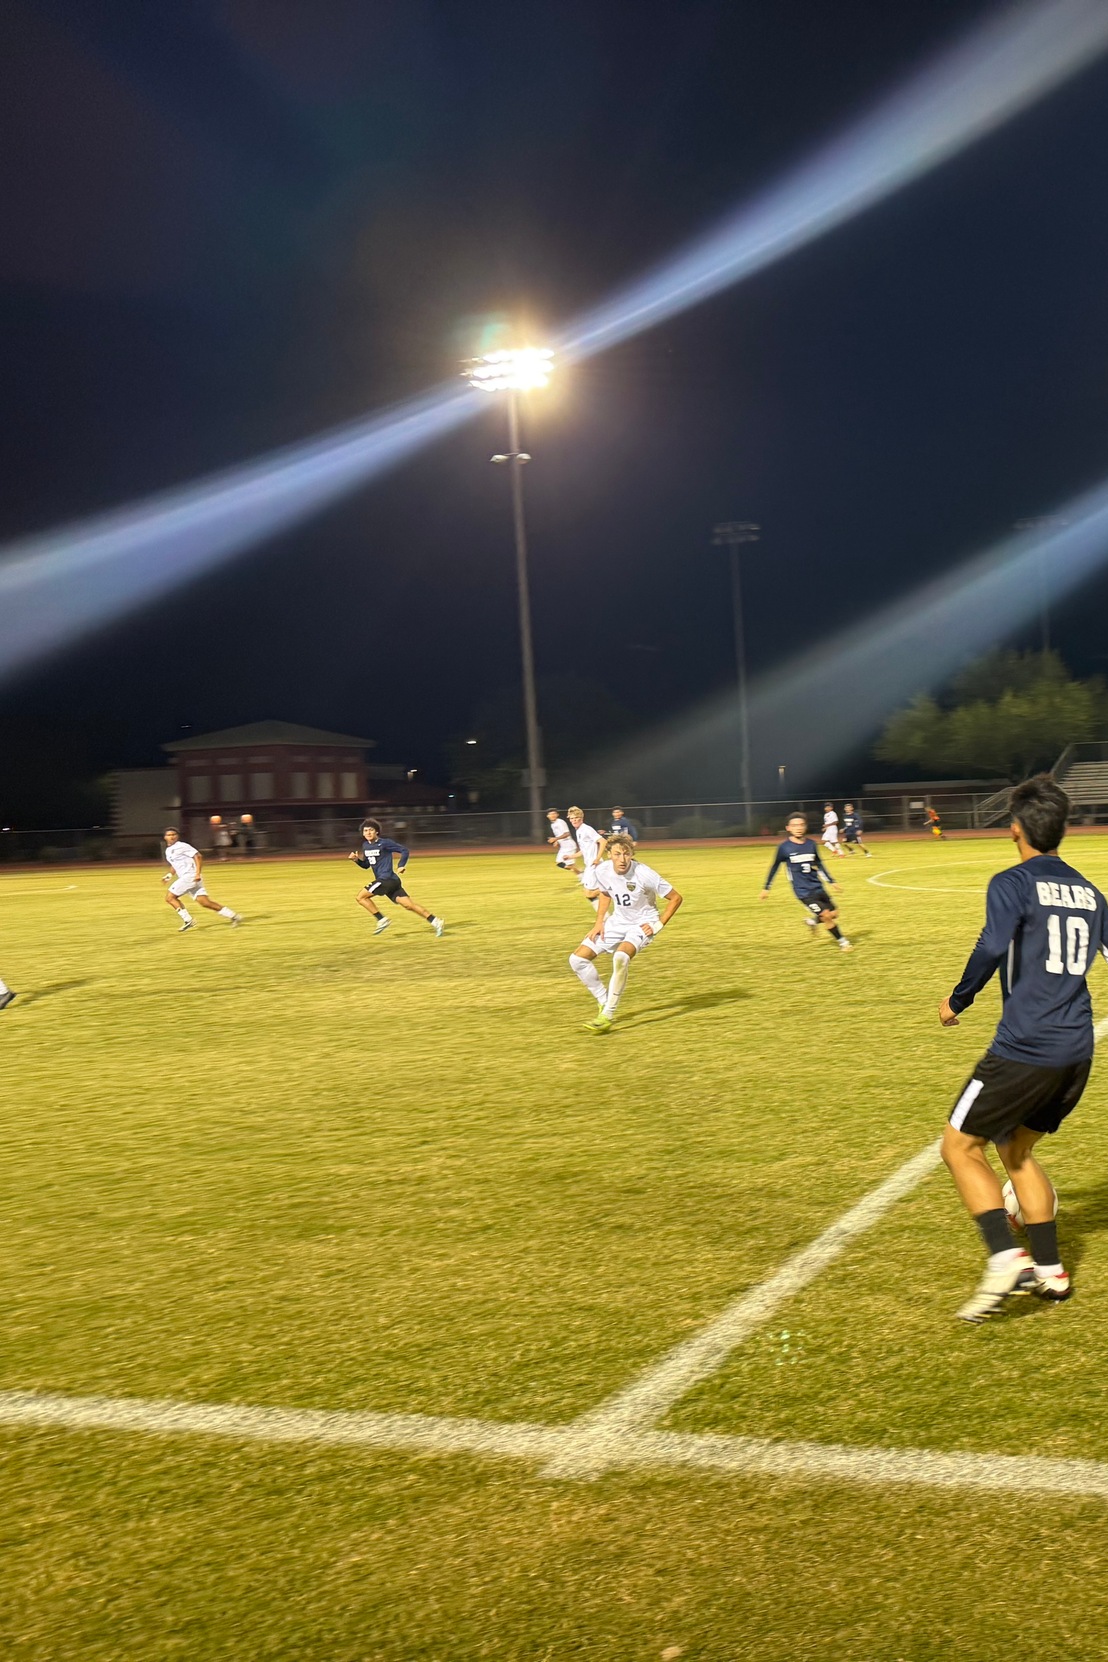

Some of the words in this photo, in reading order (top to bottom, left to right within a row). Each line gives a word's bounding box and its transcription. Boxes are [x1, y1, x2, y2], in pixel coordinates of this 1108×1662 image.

[801, 863, 811, 873] 3
[615, 894, 632, 907] 12
[1036, 881, 1098, 912] BEARS
[1045, 914, 1090, 976] 10
